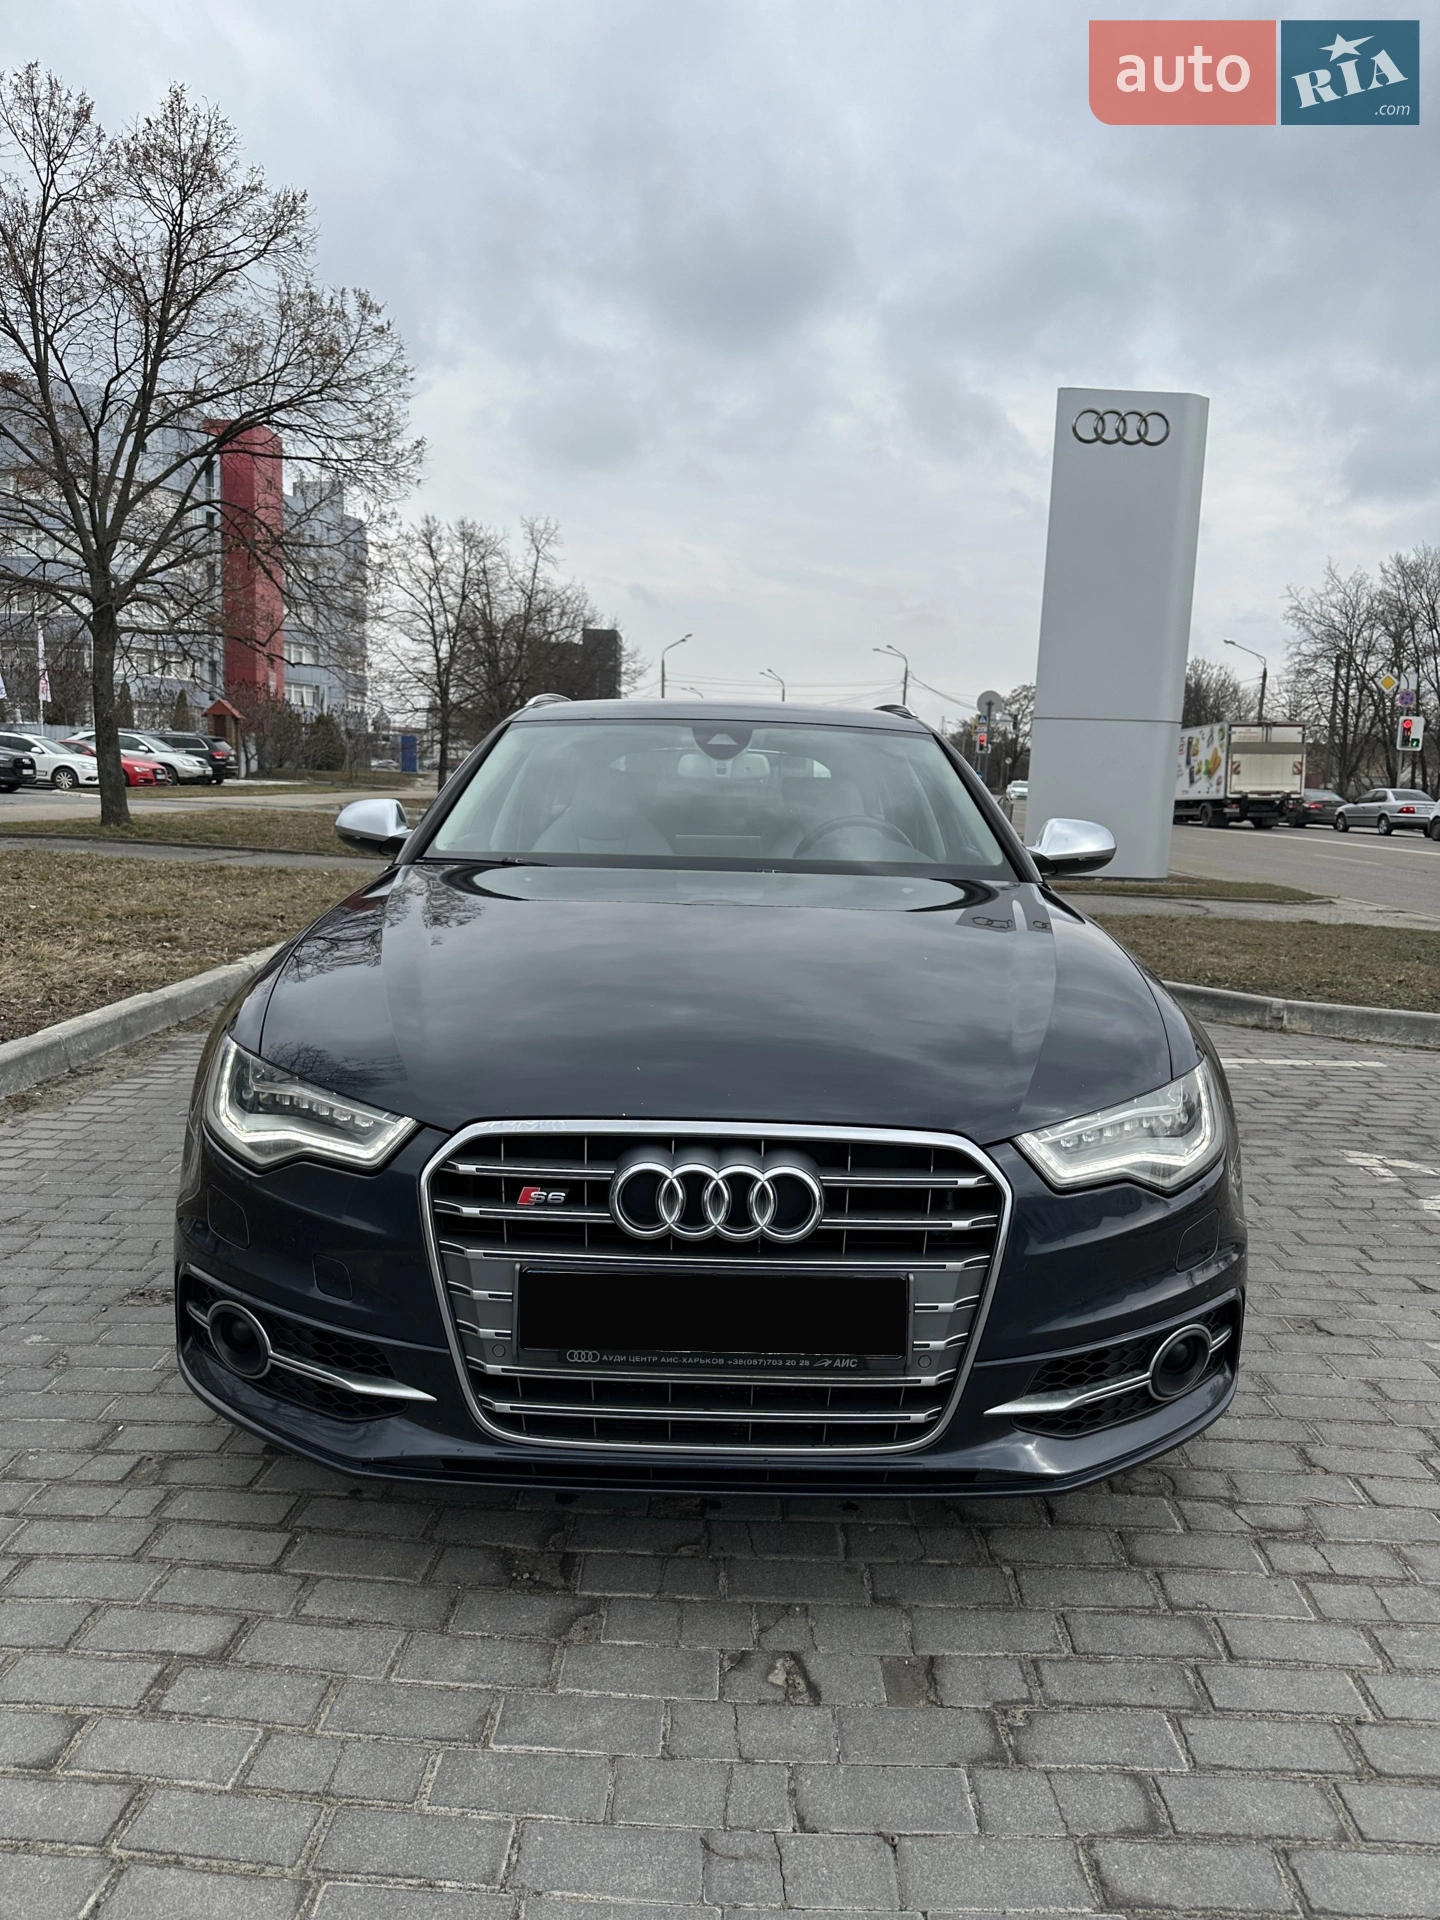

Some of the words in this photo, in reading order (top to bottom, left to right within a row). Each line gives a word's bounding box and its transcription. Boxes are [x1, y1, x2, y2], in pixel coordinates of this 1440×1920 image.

[529, 1191, 566, 1204] S6
[602, 1354, 627, 1363] АУДИ
[629, 1355, 658, 1363] ЦЕНТР
[660, 1356, 725, 1365] АИС-ХАРЬКОВ
[785, 1359, 797, 1367] 20
[799, 1359, 810, 1367] 28
[833, 1358, 858, 1368] АИС
